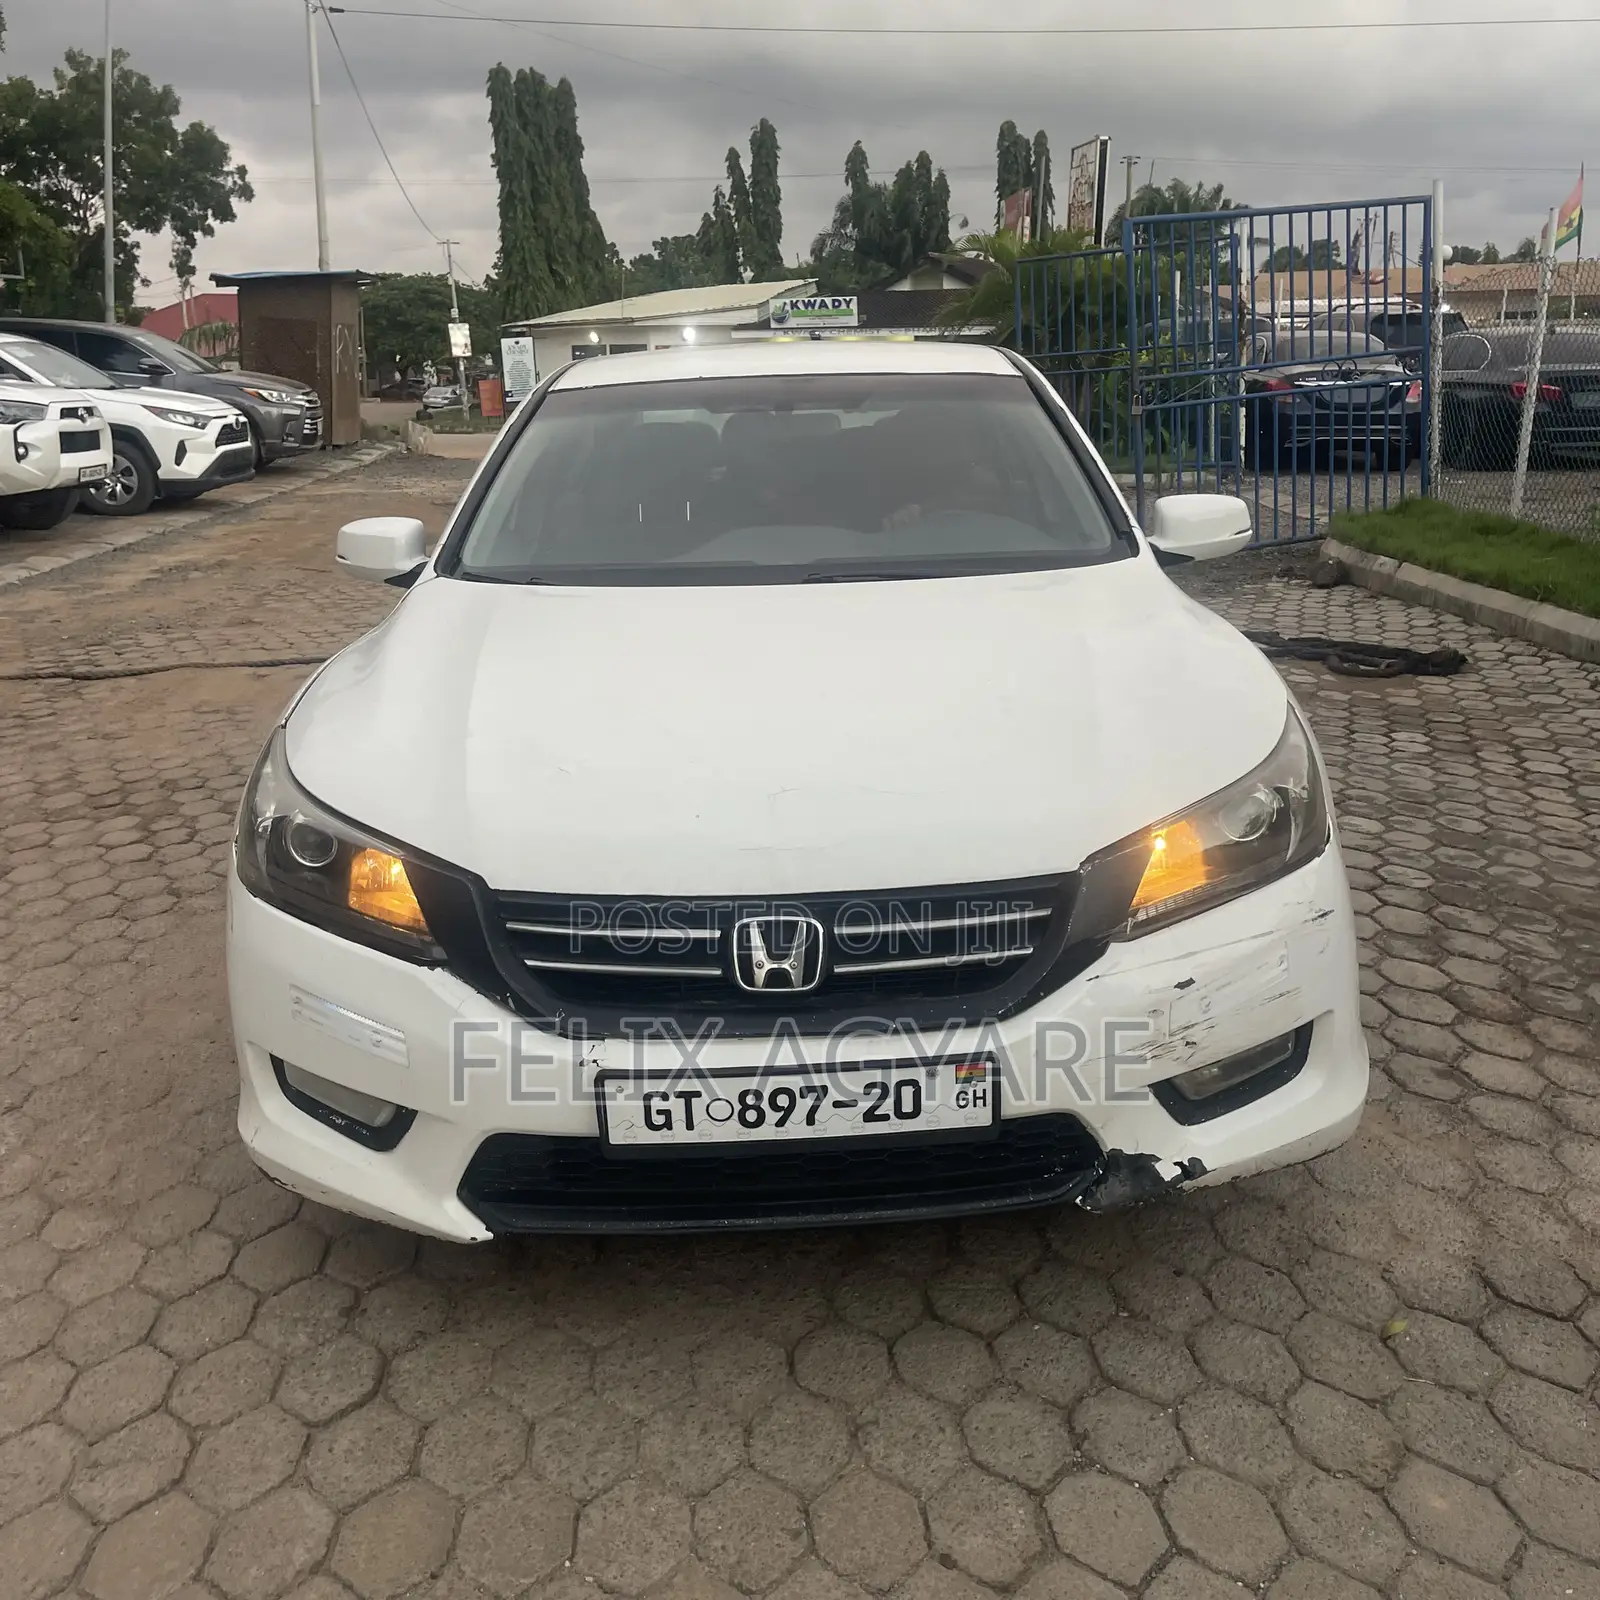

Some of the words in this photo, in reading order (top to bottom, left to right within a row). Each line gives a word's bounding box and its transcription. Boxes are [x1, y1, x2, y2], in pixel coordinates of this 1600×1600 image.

[790, 297, 853, 310] KWADY
[643, 1090, 703, 1132] GT
[736, 1077, 923, 1130] 897-20
[955, 1088, 987, 1110] GH
